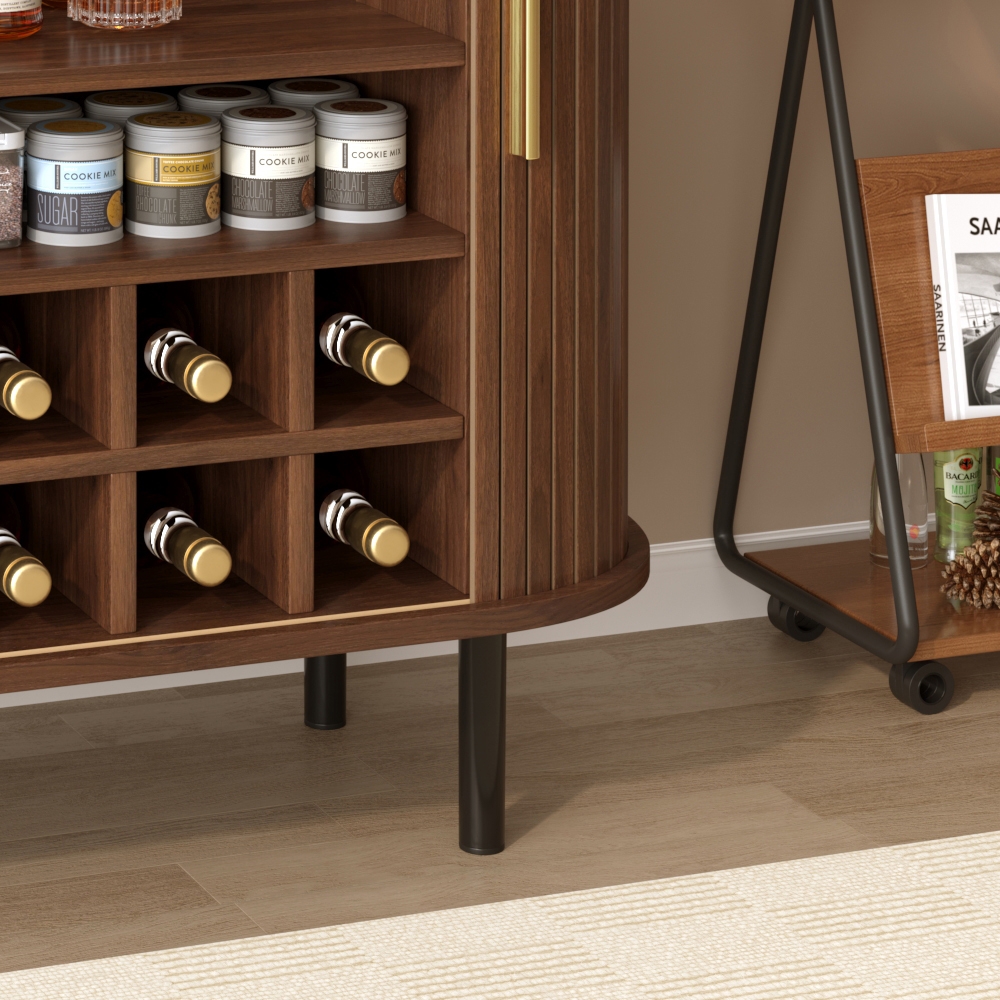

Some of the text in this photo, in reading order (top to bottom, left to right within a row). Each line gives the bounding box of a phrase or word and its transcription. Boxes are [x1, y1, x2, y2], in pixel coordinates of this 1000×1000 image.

[259, 154, 310, 166] COOKIE MIX
[352, 150, 388, 159] COOKIE
[389, 147, 402, 157] MIX
[63, 169, 117, 181] COOKIE MIX
[163, 162, 215, 173] COOKIE MIX
[231, 177, 273, 199] CHOCOLATE
[324, 170, 366, 192] CHOCOLATE
[37, 193, 79, 226] SUGAR
[135, 196, 177, 214] CHOCOLATE
[933, 284, 947, 352] SAARINEN
